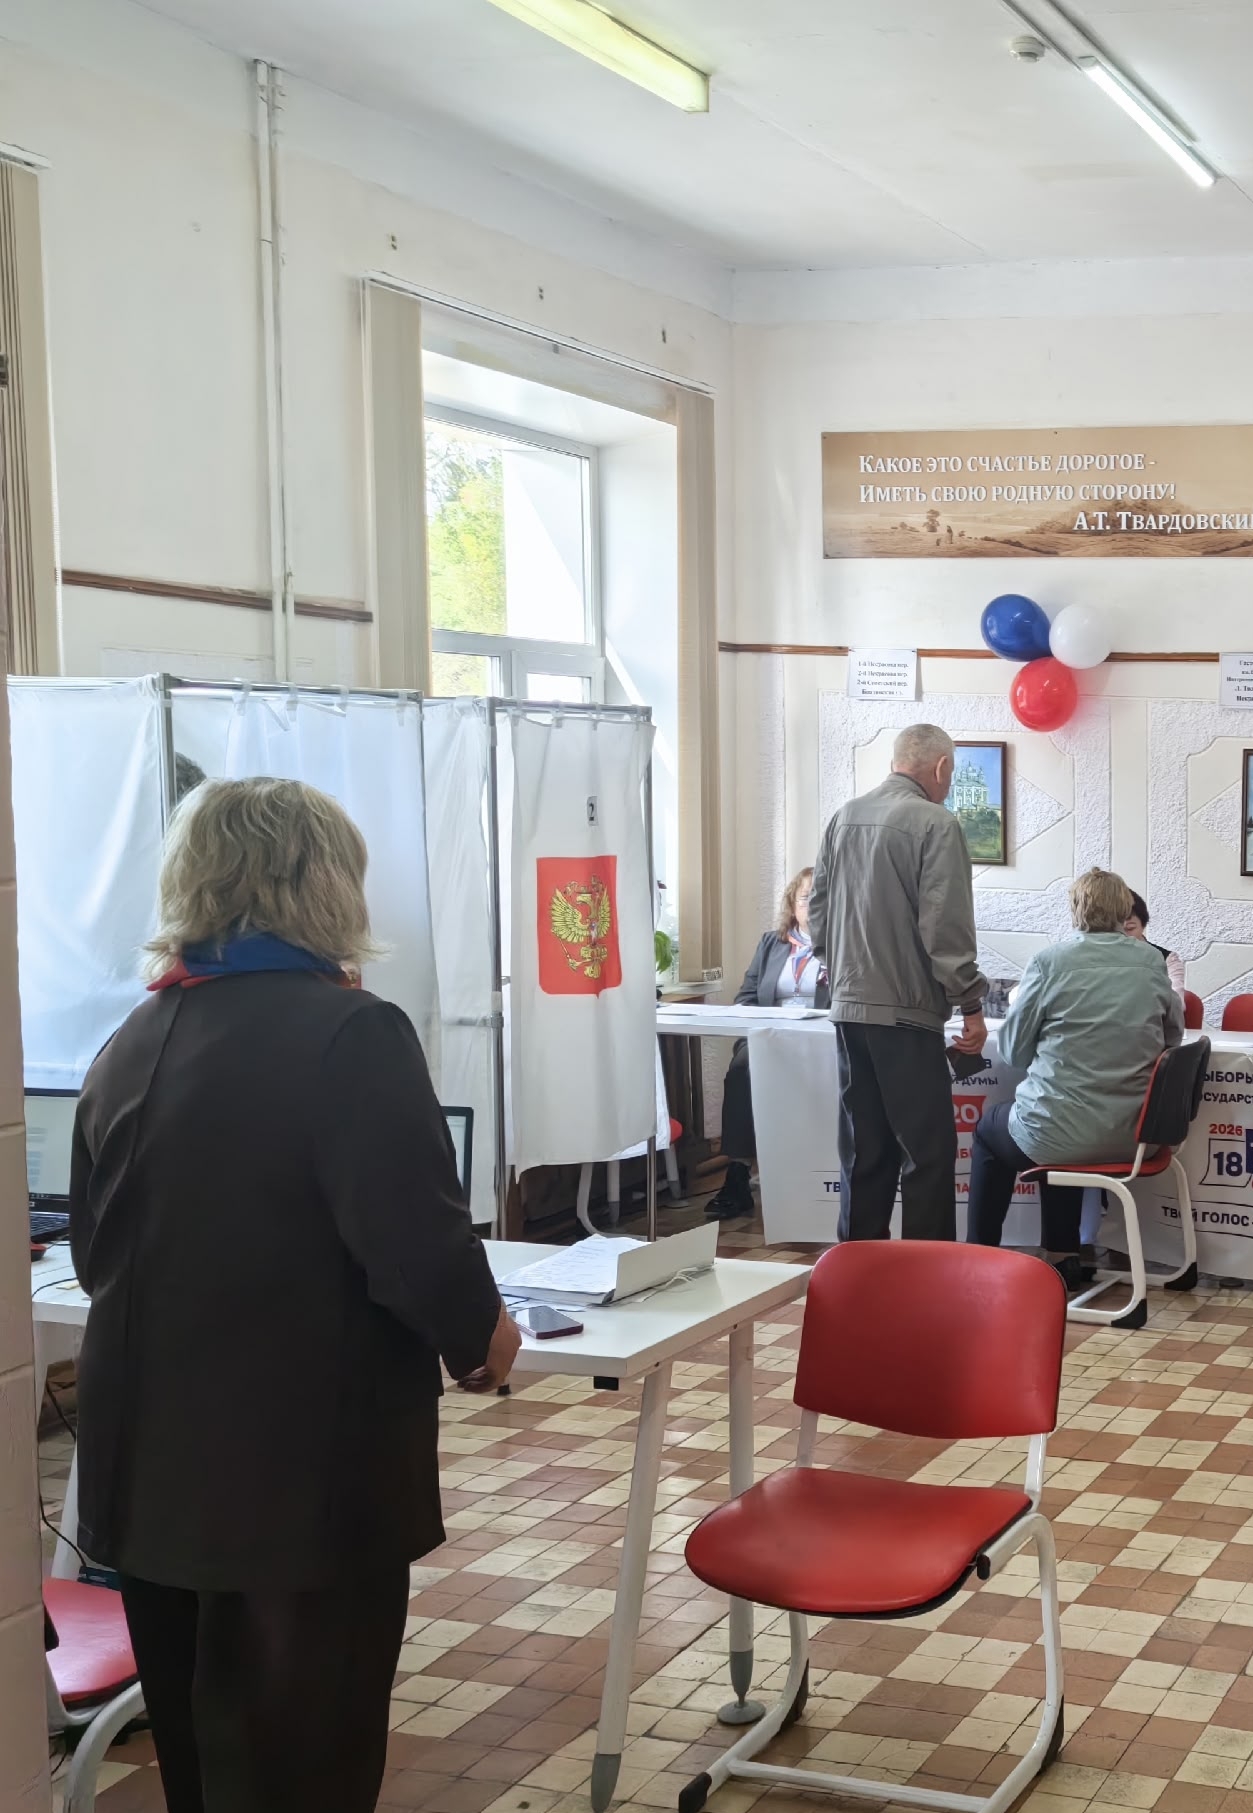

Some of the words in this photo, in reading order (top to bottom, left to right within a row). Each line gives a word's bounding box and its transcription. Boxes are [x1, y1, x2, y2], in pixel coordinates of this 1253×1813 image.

[1073, 511, 1111, 531] А.Т.
[962, 1077, 998, 1086] ДУМЫ
[1209, 1123, 1243, 1136] 2026
[1213, 1151, 1243, 1176] 18
[1161, 1206, 1198, 1222] ТВЙ
[1202, 1211, 1249, 1227] ГОЛОС
